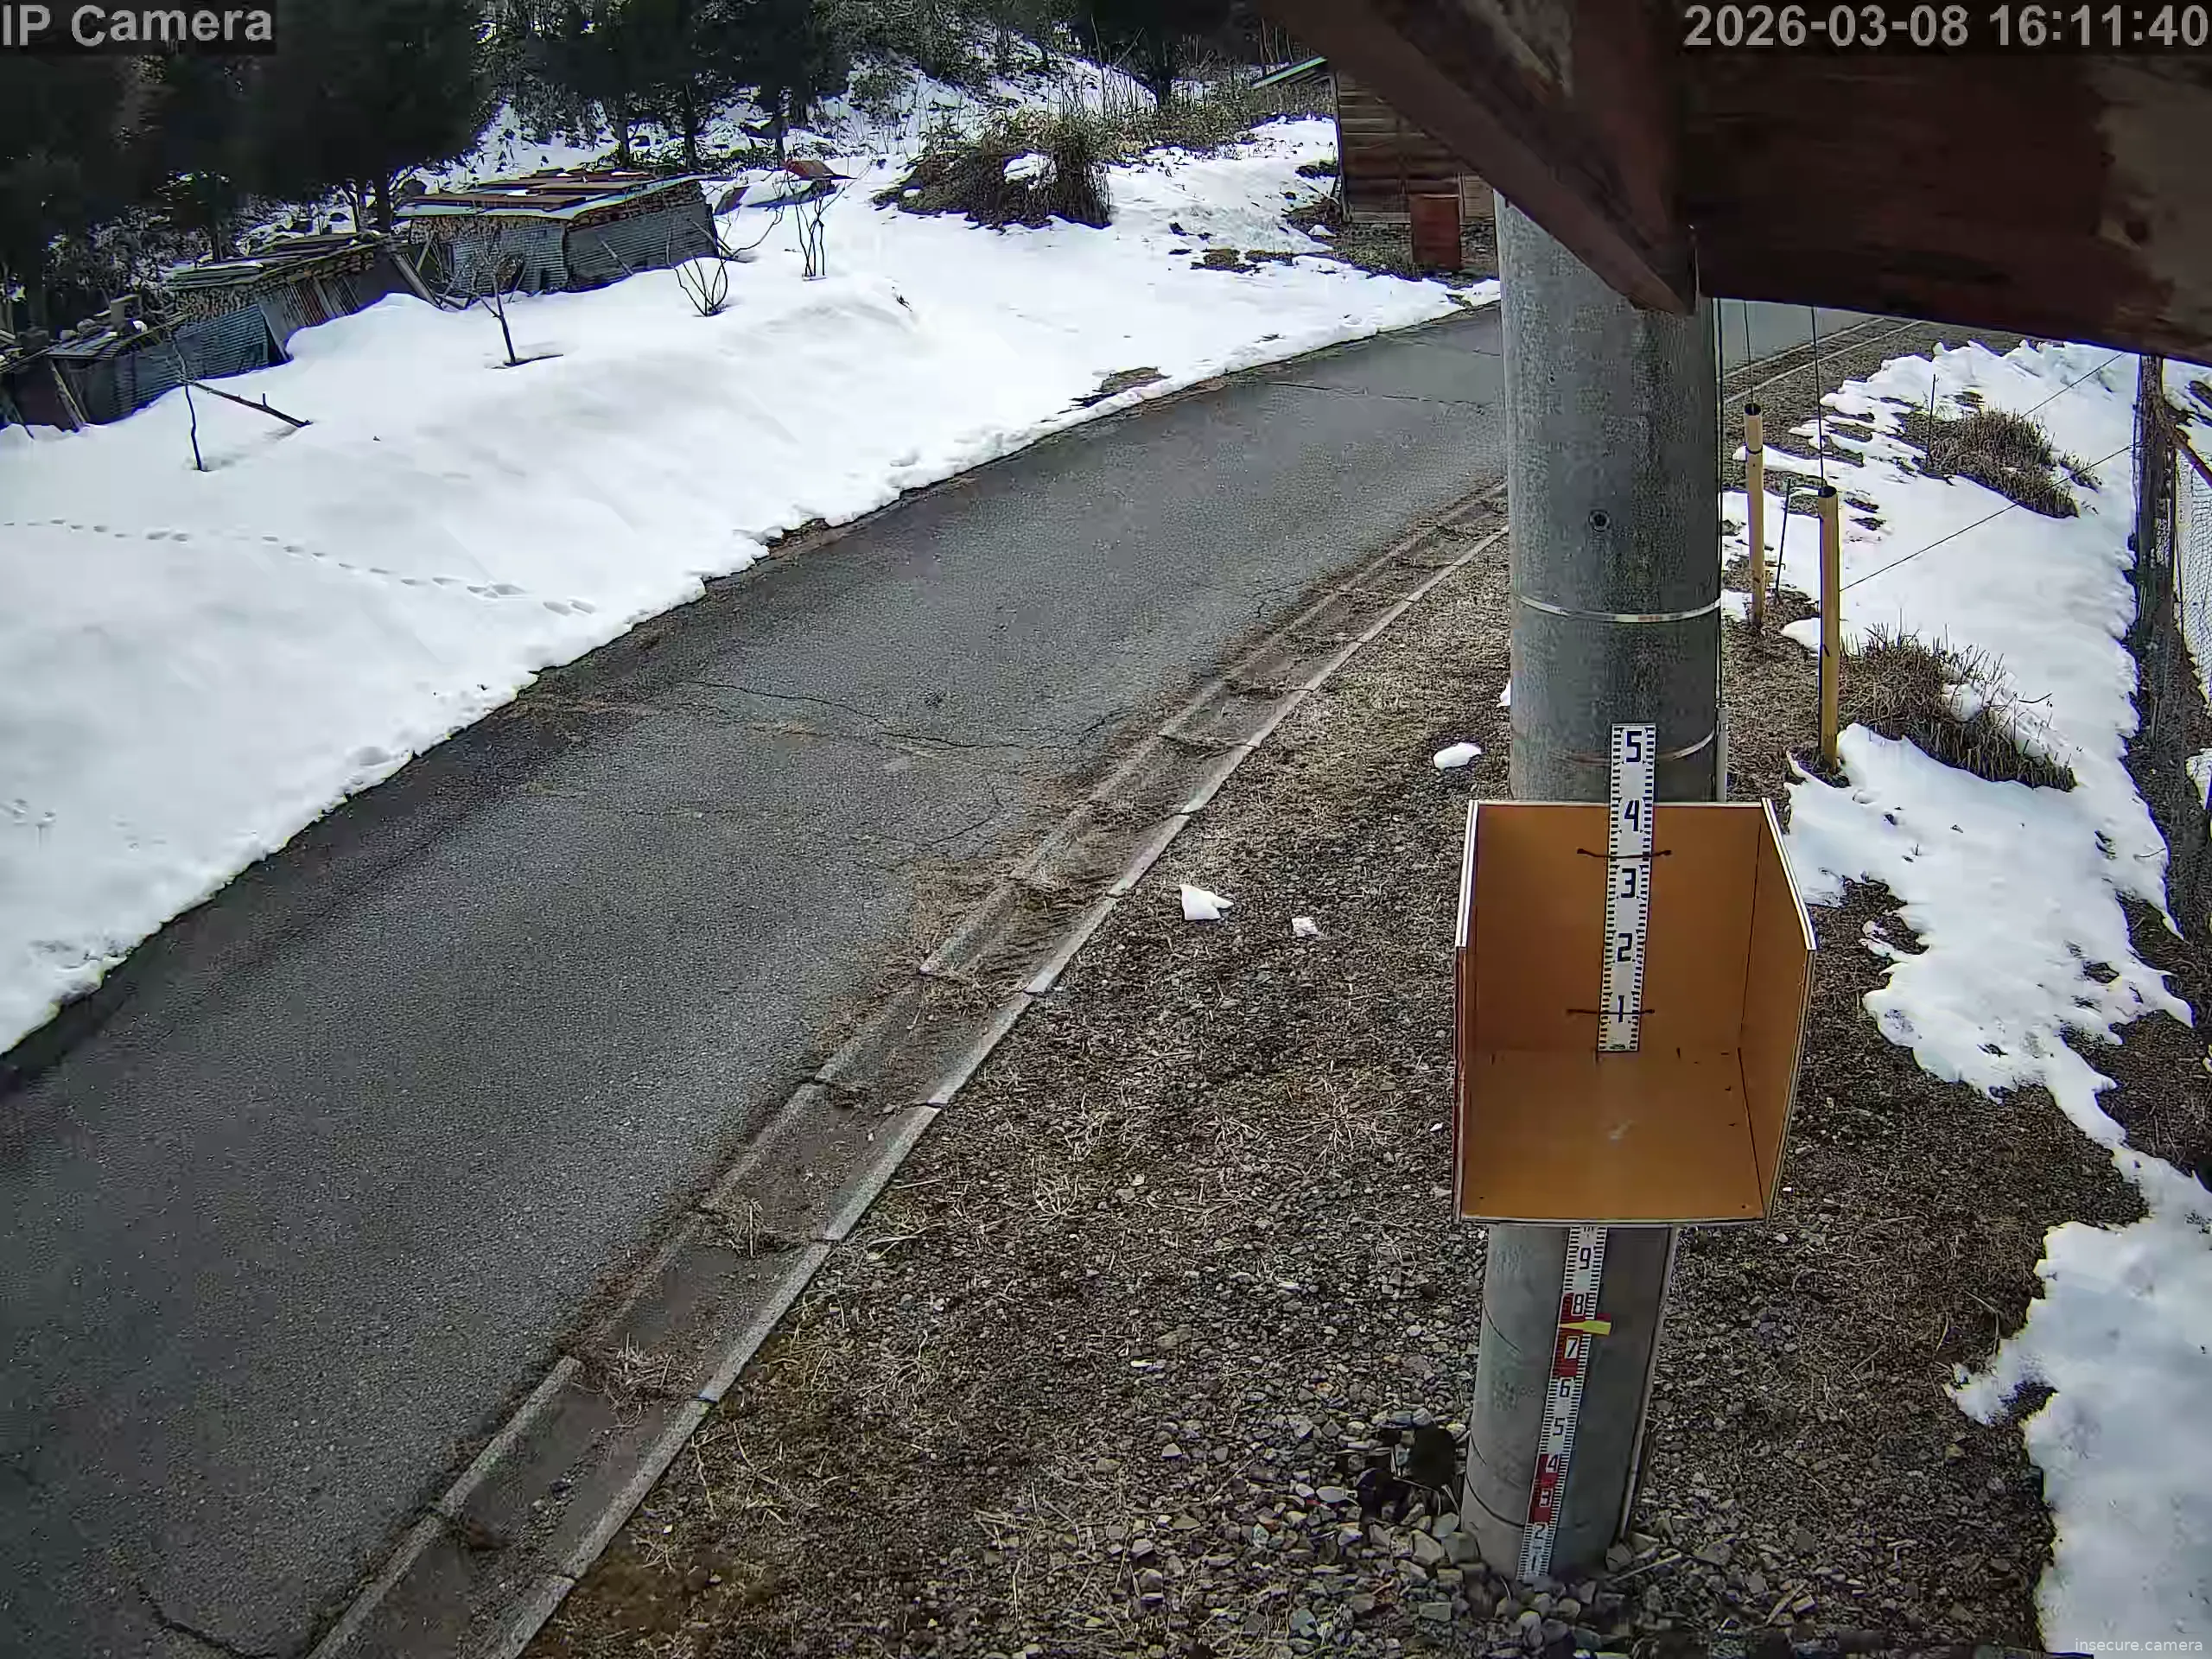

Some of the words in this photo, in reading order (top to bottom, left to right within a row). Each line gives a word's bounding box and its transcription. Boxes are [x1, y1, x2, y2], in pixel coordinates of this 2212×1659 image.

[1625, 730, 1642, 762] 5
[1624, 799, 1640, 832] 4
[1620, 868, 1637, 898] 3
[1617, 932, 1633, 963] 2
[1618, 995, 1624, 1023] 1
[1579, 1247, 1592, 1270] 9
[1573, 1294, 1585, 1314] 8
[1567, 1336, 1580, 1357] 7
[1559, 1378, 1571, 1398] 6
[1552, 1417, 1565, 1436] 5
[1548, 1453, 1559, 1472] 4
